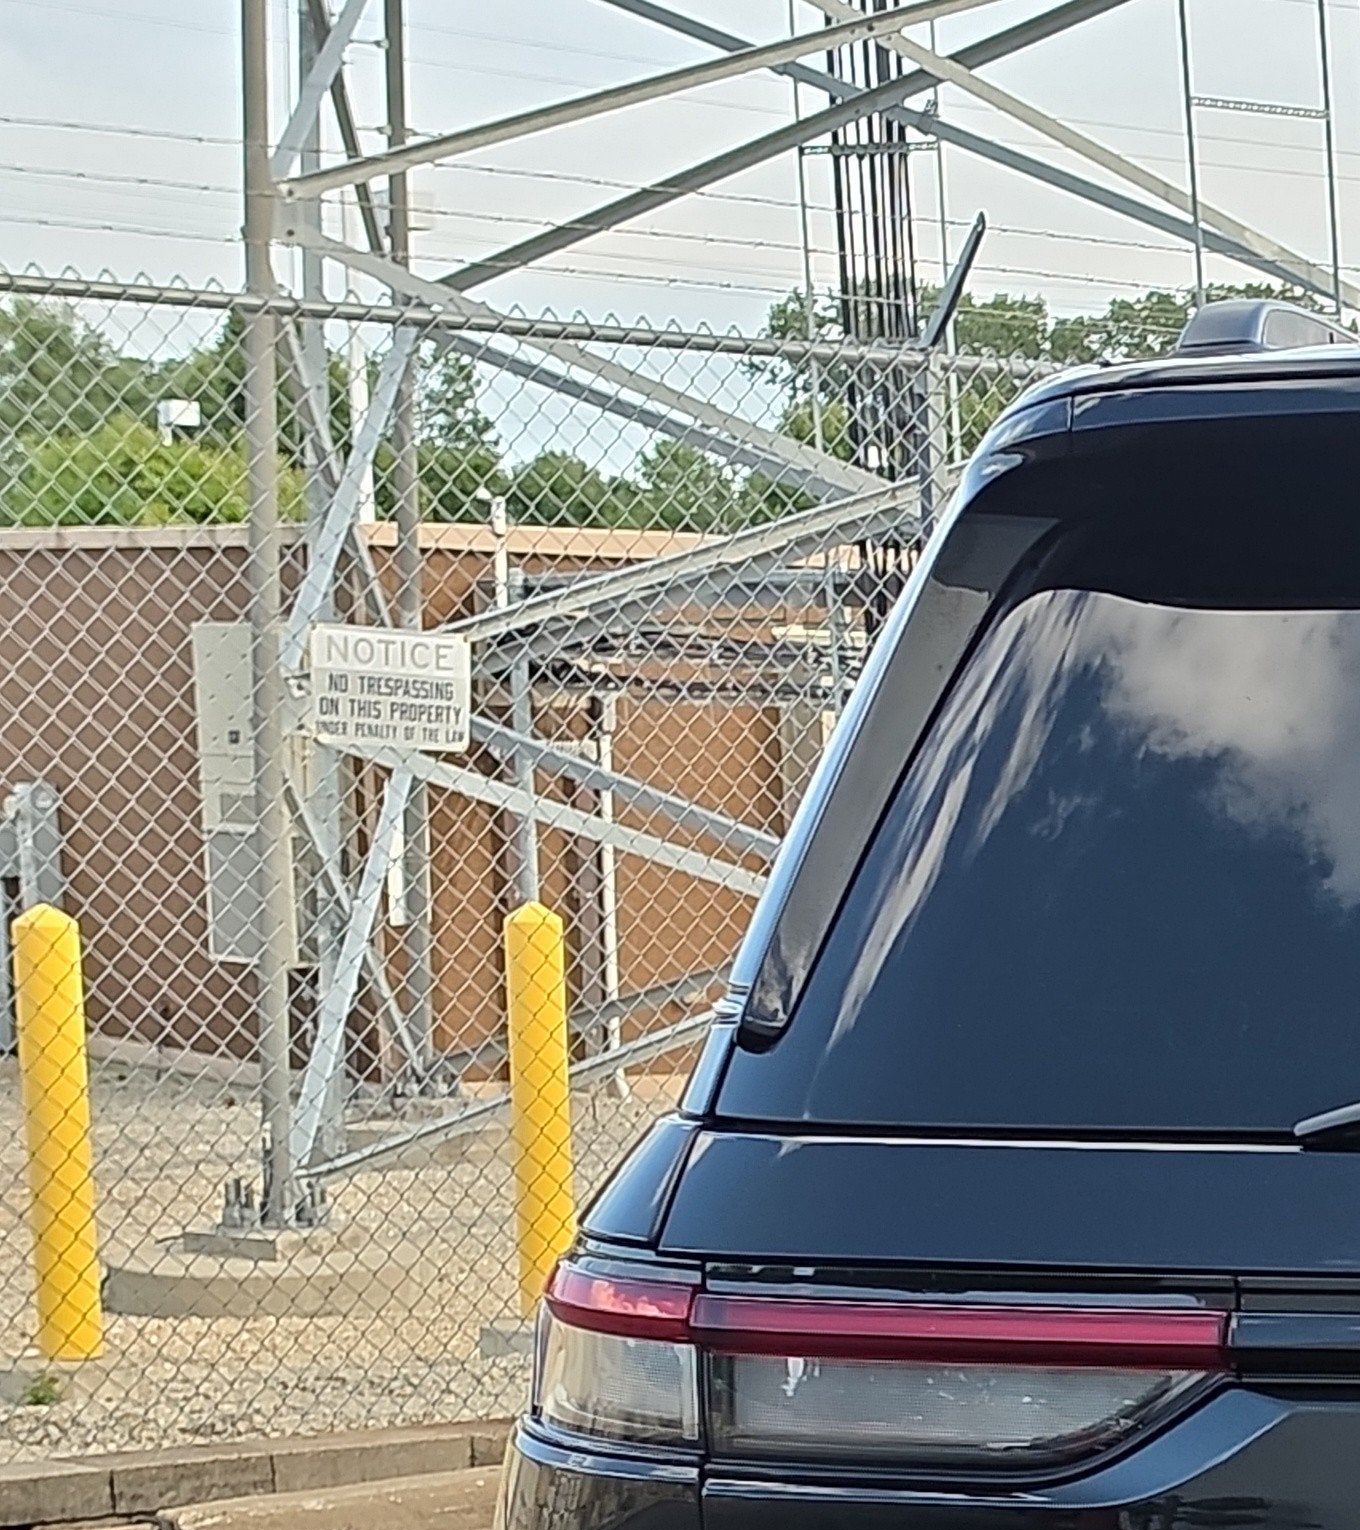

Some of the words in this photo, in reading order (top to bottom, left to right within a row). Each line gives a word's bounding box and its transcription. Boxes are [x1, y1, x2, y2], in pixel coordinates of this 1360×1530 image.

[326, 635, 454, 671] NOTICE
[328, 673, 349, 693] NO
[358, 675, 454, 701] TRESPASSING
[319, 696, 340, 716] ON
[349, 698, 382, 720] THIS
[390, 701, 462, 725] PROPERTY
